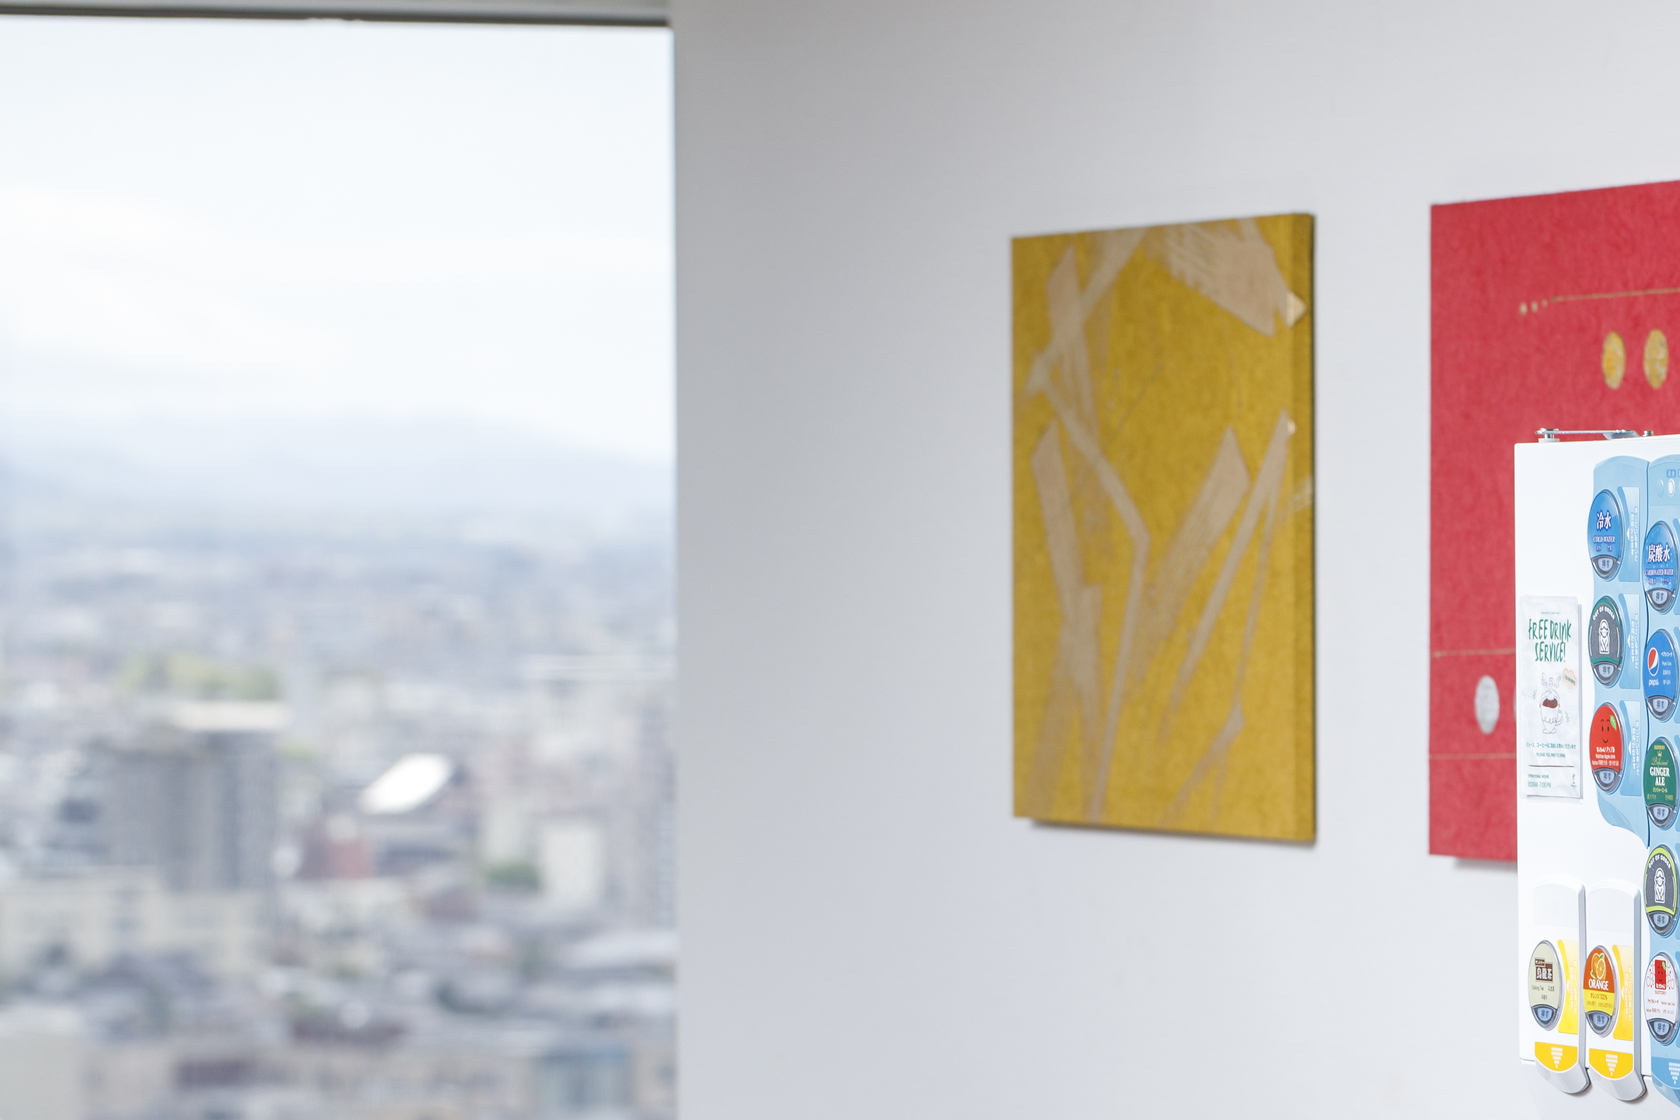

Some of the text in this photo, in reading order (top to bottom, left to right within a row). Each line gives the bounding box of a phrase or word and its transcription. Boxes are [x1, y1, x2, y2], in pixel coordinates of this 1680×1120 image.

[1596, 511, 1612, 530] 冷水
[1648, 544, 1670, 563] 炭酸水
[1528, 618, 1548, 640] FREE
[1535, 641, 1566, 662] SERVICE!
[1648, 678, 1659, 687] pepsi
[1650, 767, 1670, 777] GINGER
[1655, 777, 1665, 786] ALE
[1588, 978, 1609, 990] ORANGE
